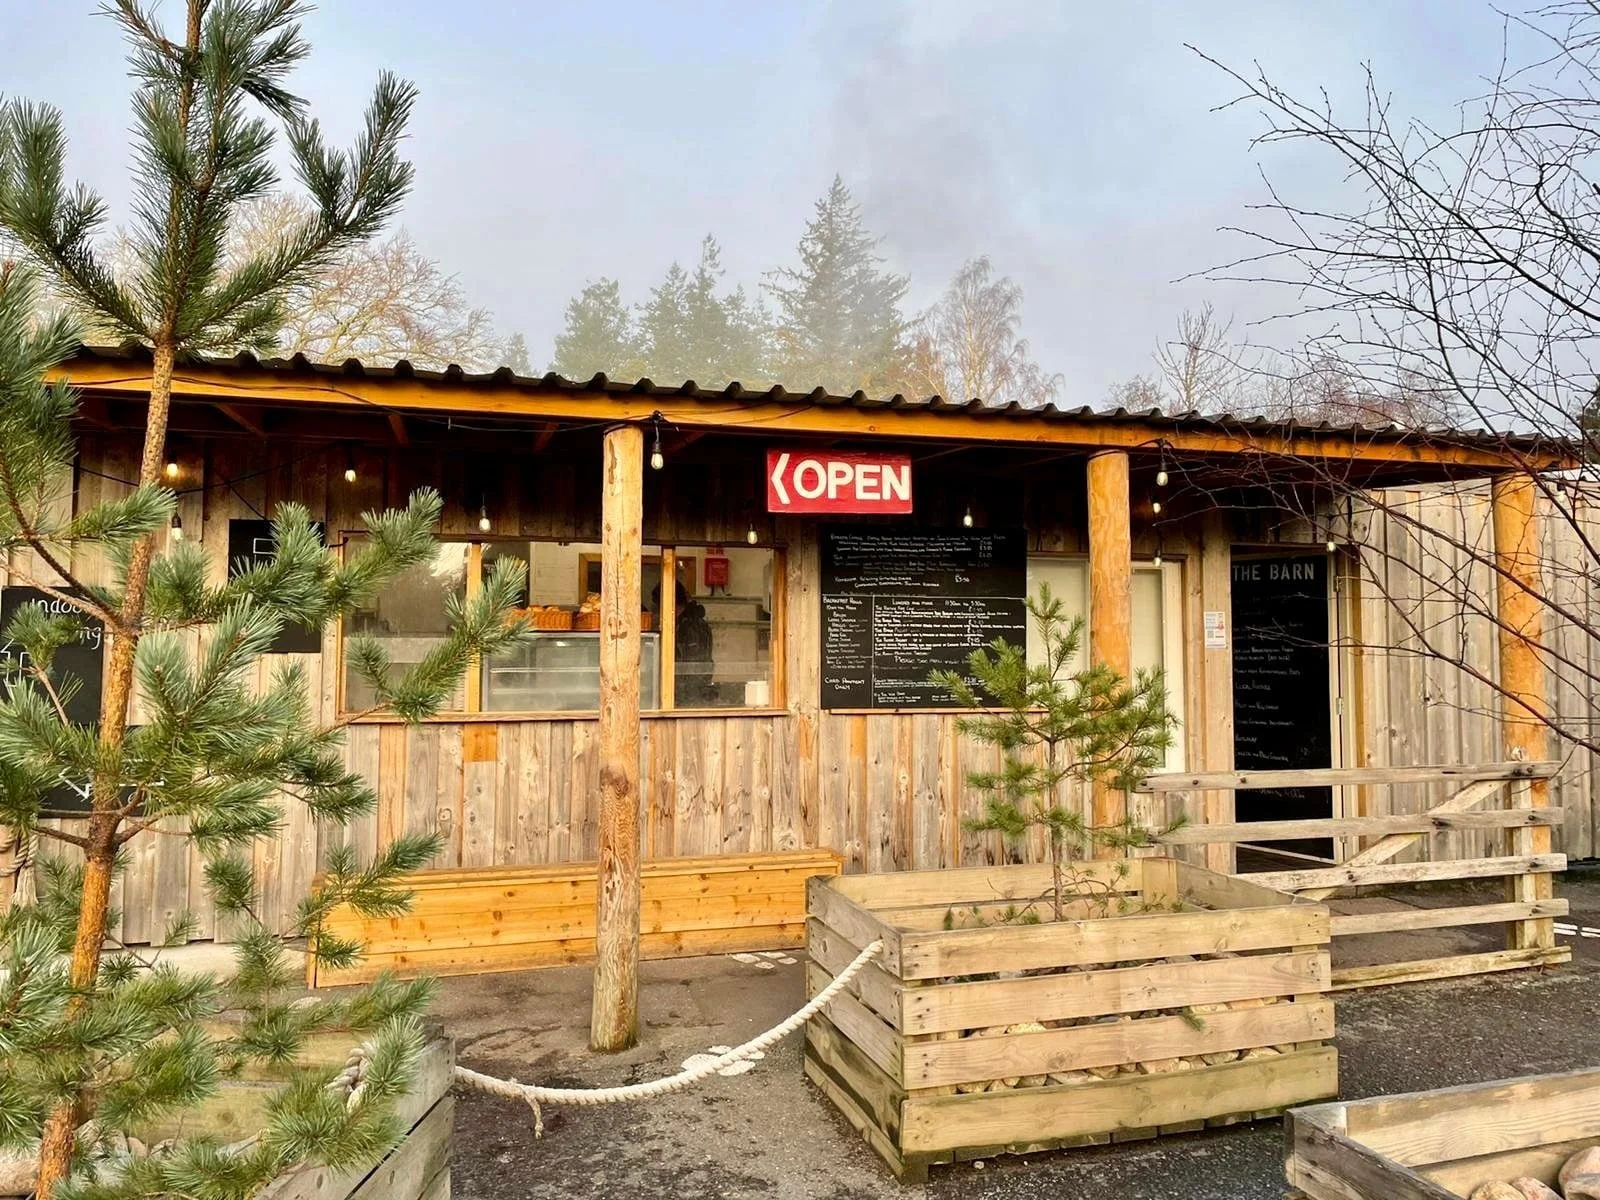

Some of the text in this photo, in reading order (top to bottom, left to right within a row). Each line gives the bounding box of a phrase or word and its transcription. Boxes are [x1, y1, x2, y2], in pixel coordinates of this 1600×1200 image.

[792, 459, 910, 501] OPEN
[1232, 562, 1316, 581] THE BARN
[31, 597, 82, 614] Indoo
